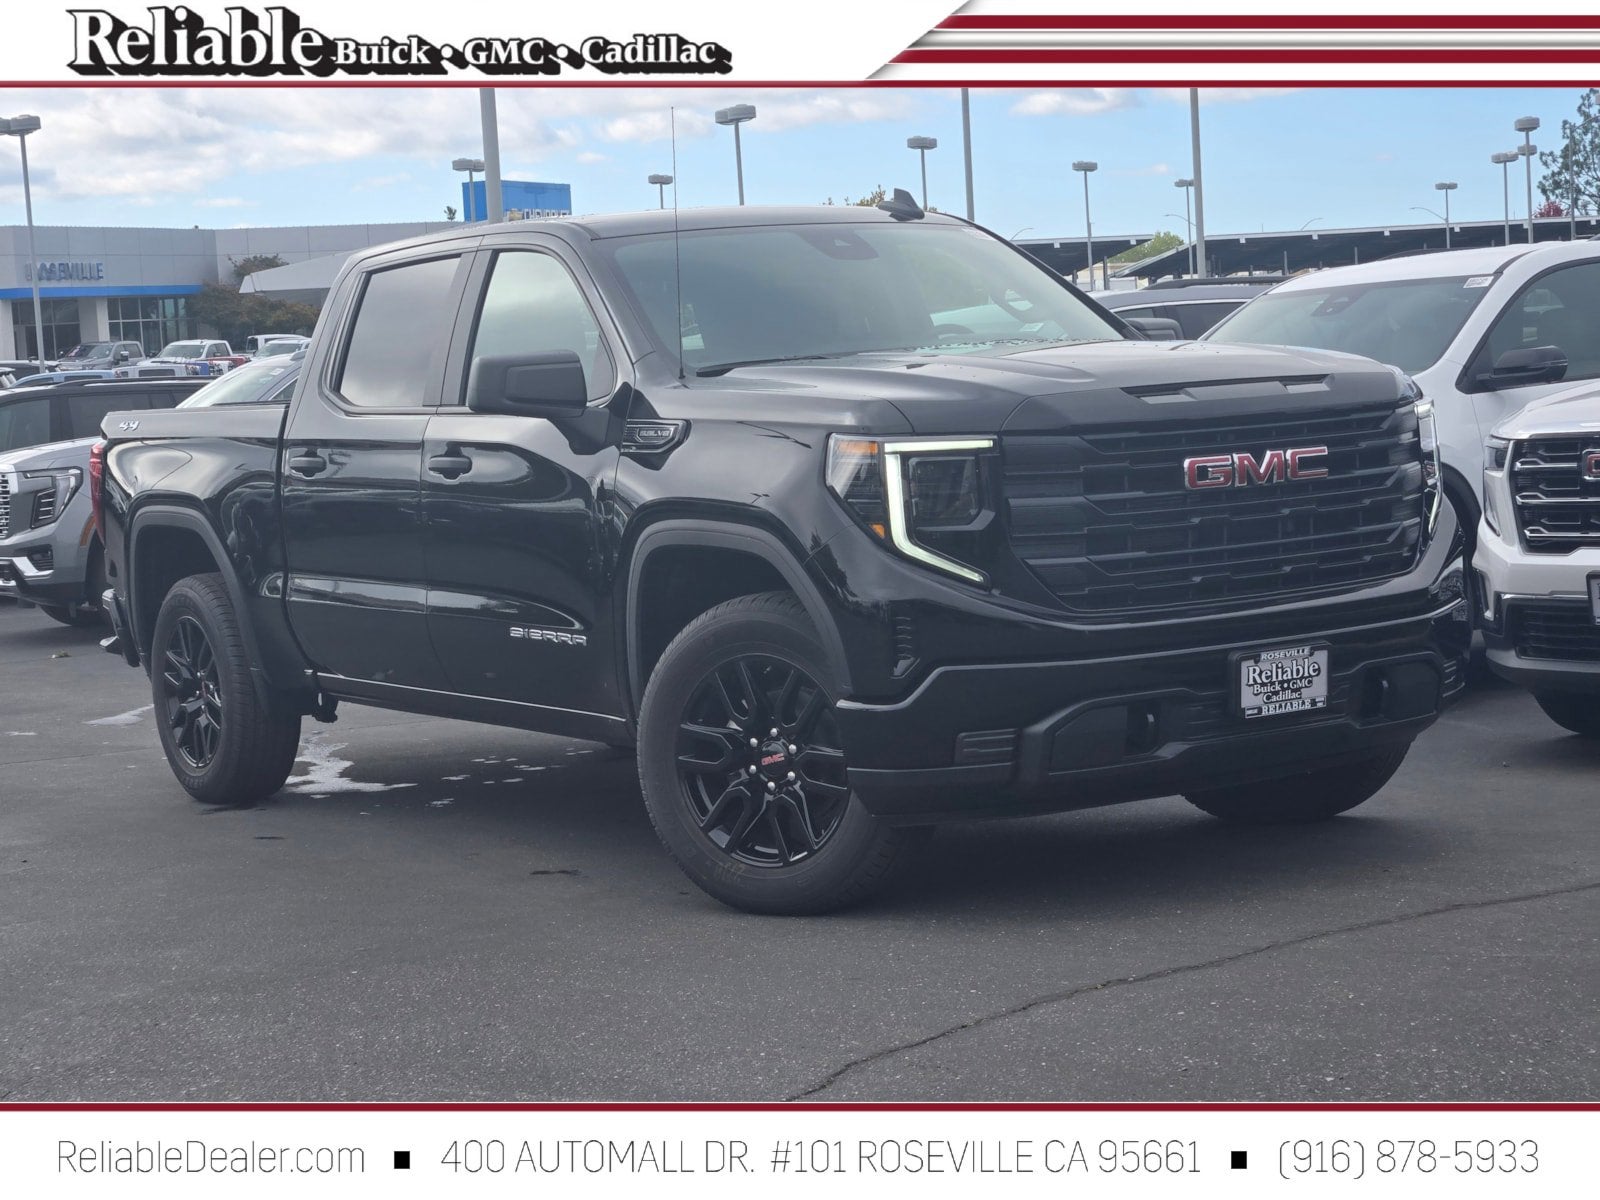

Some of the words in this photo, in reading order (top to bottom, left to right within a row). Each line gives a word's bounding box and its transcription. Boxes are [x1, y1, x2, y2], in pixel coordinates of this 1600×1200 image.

[1183, 446, 1329, 490] GMC
[509, 626, 587, 646] SIERRA
[1261, 648, 1309, 661] ROSEVILLE
[1246, 658, 1321, 686] Reliable
[1253, 681, 1282, 695] Buick
[1289, 677, 1313, 690] GMC
[1262, 689, 1302, 703] Cadillac
[1261, 699, 1312, 716] RELIABLE
